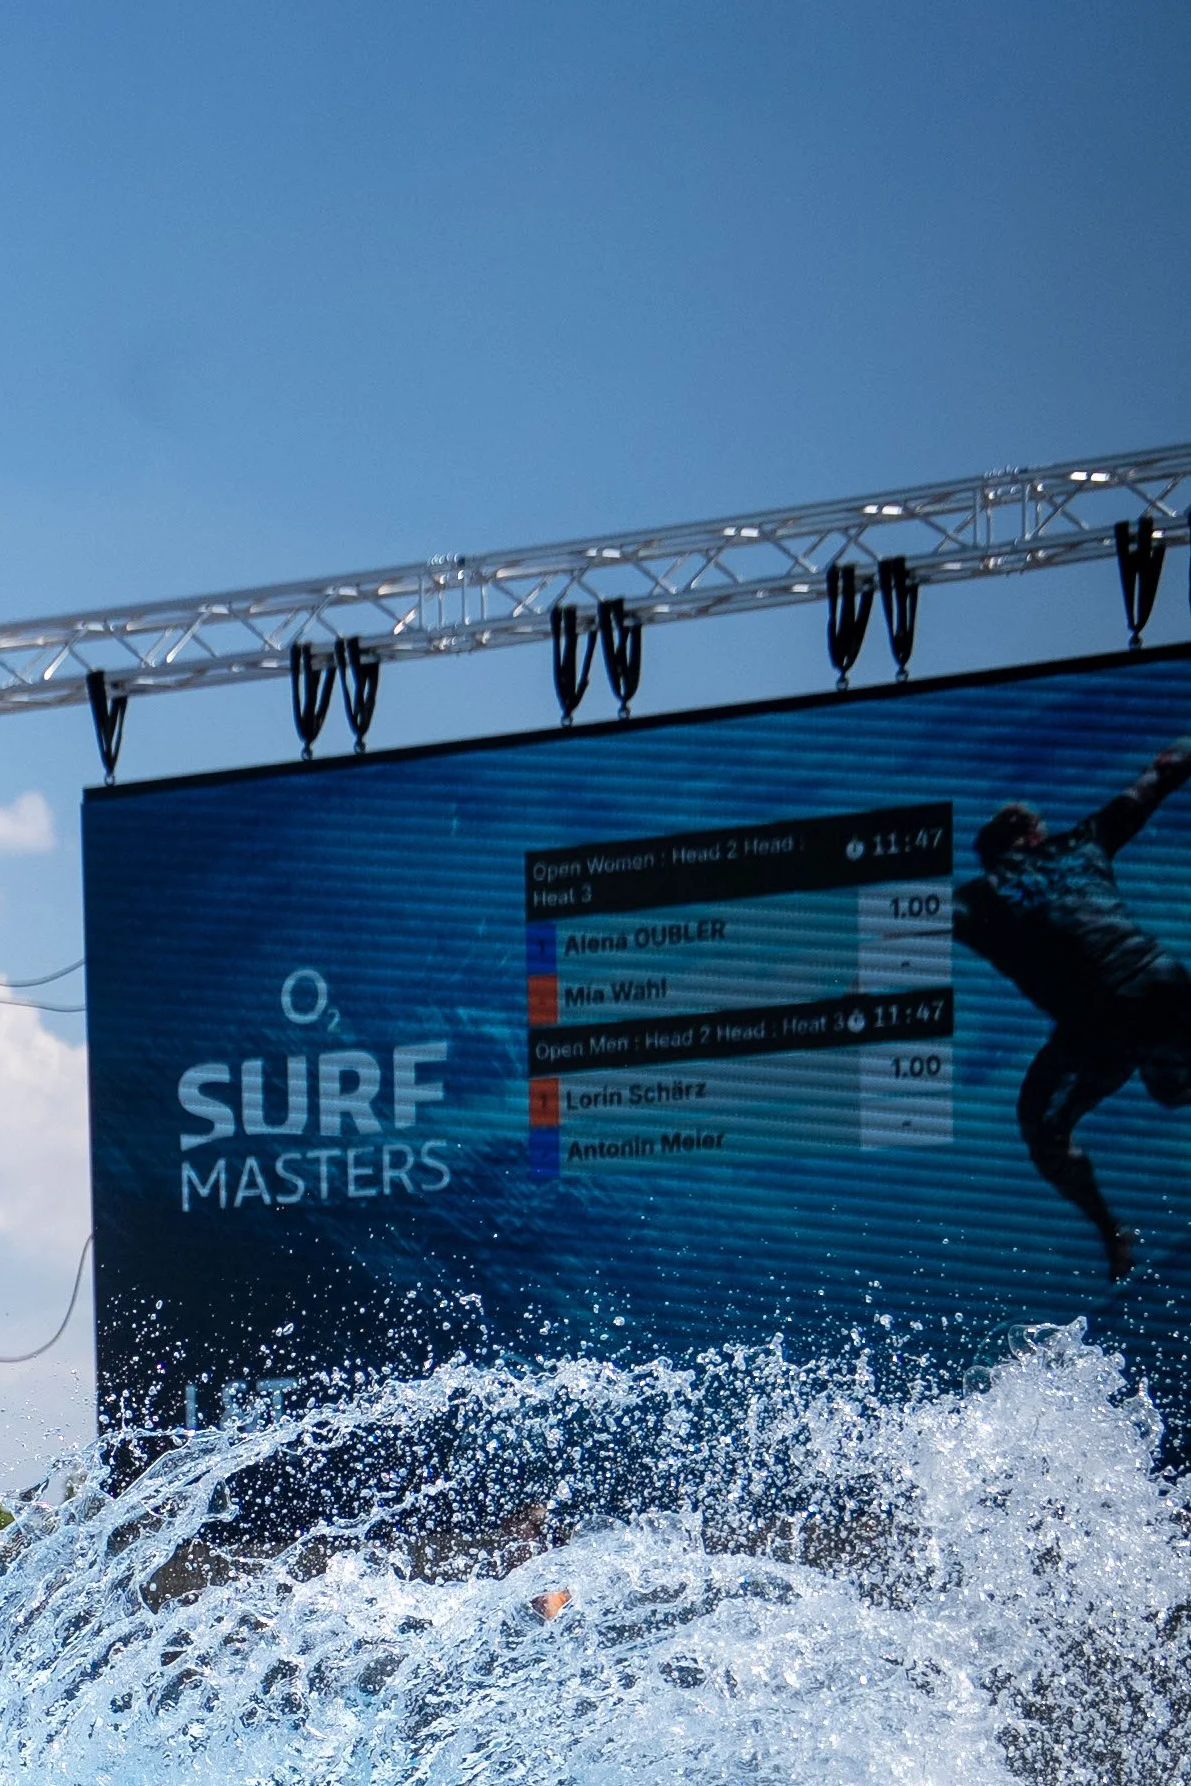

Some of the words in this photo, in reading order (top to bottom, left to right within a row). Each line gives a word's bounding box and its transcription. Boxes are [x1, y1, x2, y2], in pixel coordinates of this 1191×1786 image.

[872, 827, 944, 856] 11:47
[532, 861, 582, 883] Open
[587, 851, 655, 876] Women
[672, 843, 721, 864] Head
[726, 839, 738, 860] 2
[744, 834, 794, 855] Head
[533, 887, 576, 908] Heat
[582, 884, 593, 904] 3
[890, 895, 941, 920] 1.00
[565, 934, 628, 957] Alena
[565, 986, 606, 1007] Mia
[611, 978, 668, 1002] Wahl
[873, 1000, 944, 1028] 11:47
[535, 1039, 585, 1063] Open
[590, 1037, 629, 1055] Men
[645, 1029, 694, 1049] Head
[700, 1025, 711, 1044] 2
[717, 1019, 766, 1041] Head
[783, 1014, 827, 1035] Heat
[832, 1010, 844, 1032] 3
[891, 1055, 941, 1079] 1.00
[177, 1041, 448, 1152] SURF
[566, 1083, 623, 1109] Lorin
[628, 1080, 707, 1105] Schärz
[568, 1137, 655, 1160] Antonin
[660, 1130, 724, 1152] Meier
[180, 1139, 451, 1213] MASTERS
